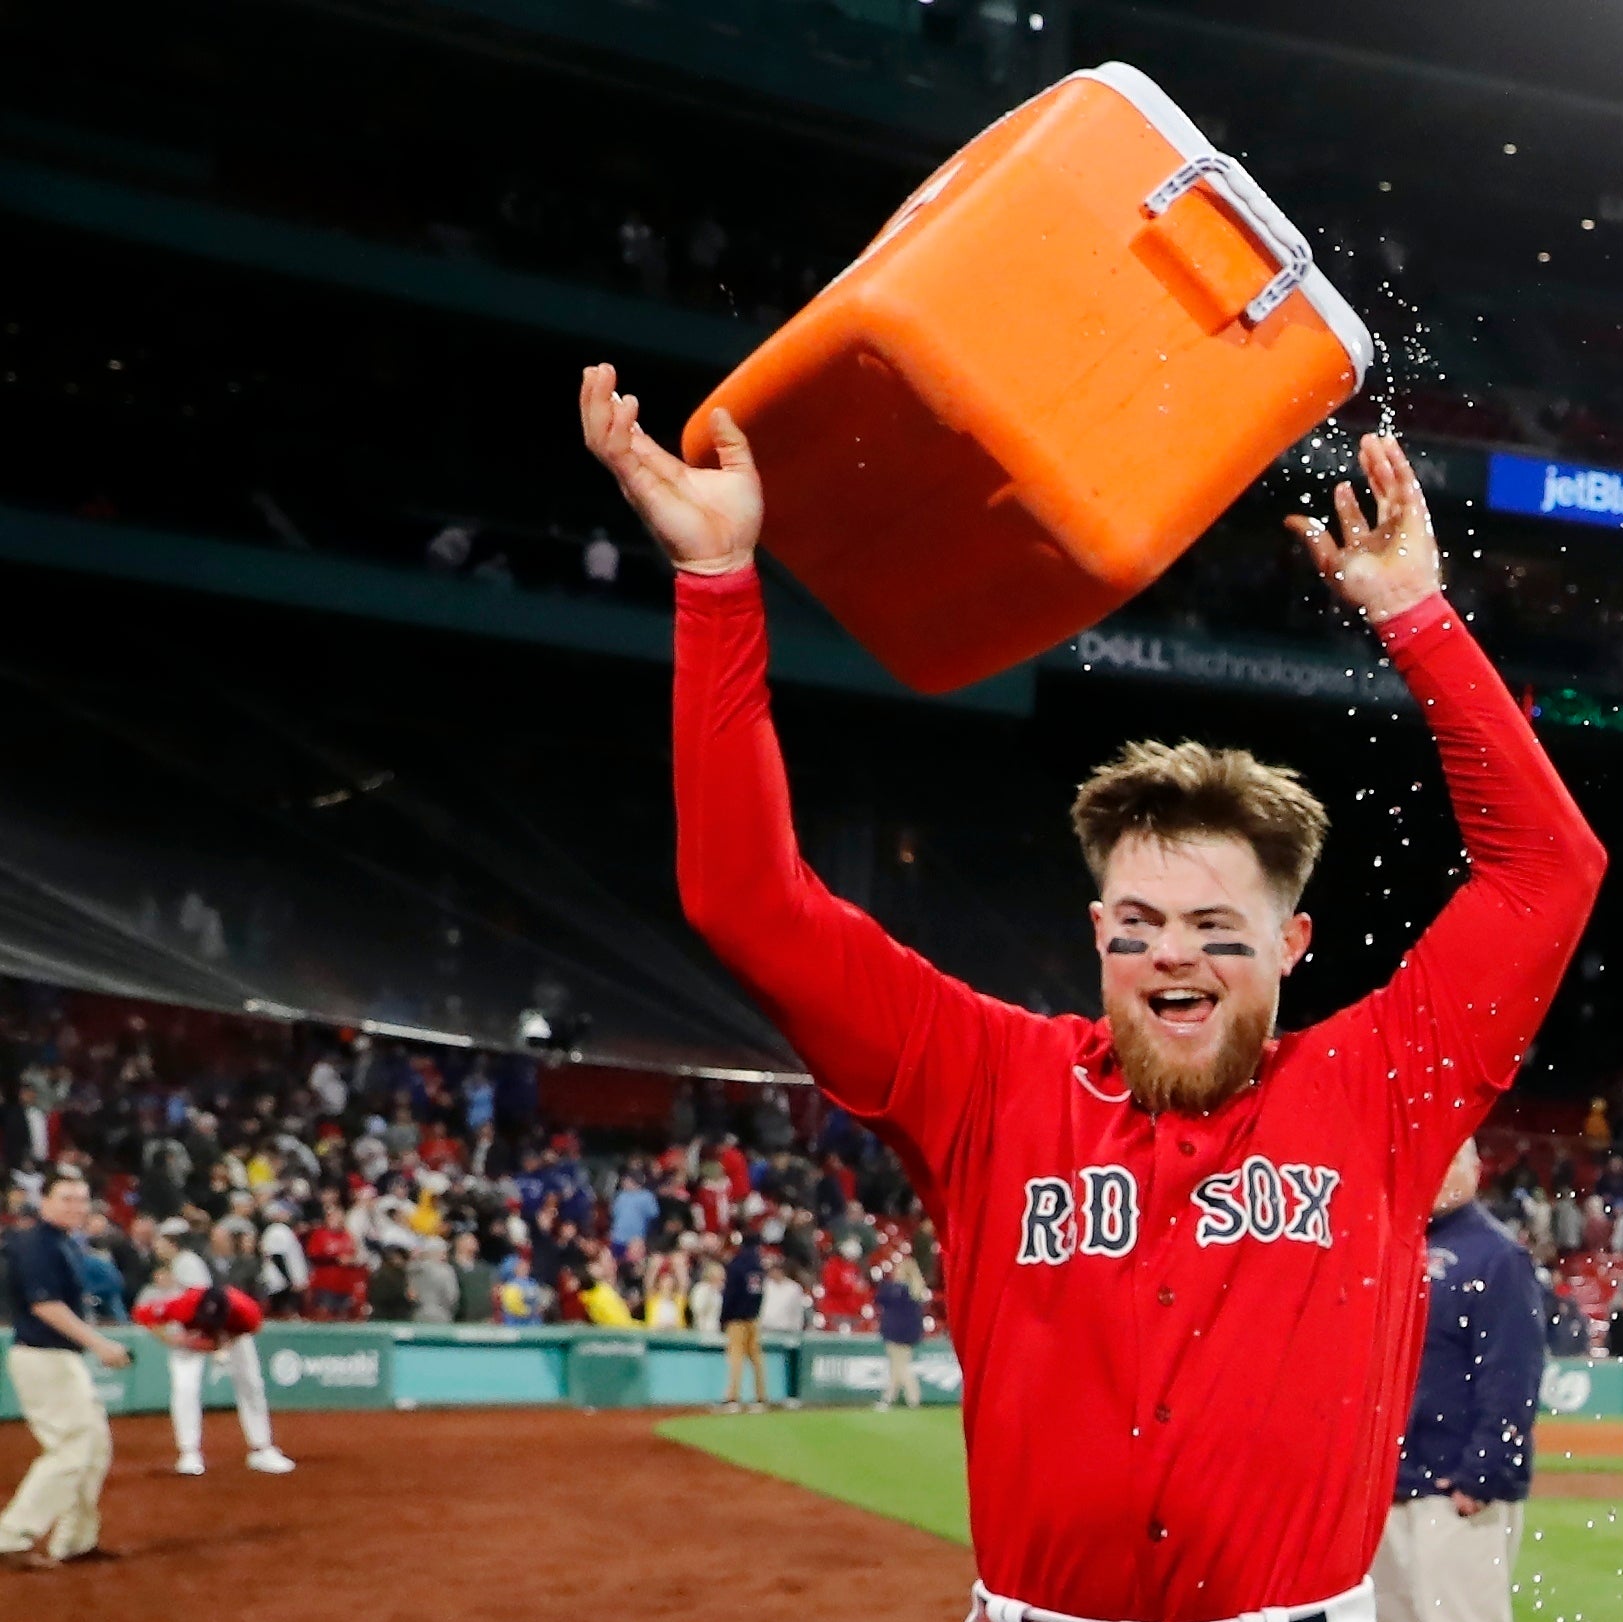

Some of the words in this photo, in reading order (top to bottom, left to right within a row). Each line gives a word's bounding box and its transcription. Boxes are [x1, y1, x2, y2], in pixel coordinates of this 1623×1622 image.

[1078, 631, 1172, 671] DELL
[1016, 1164, 1140, 1267] RD
[1190, 1154, 1340, 1249] SOX
